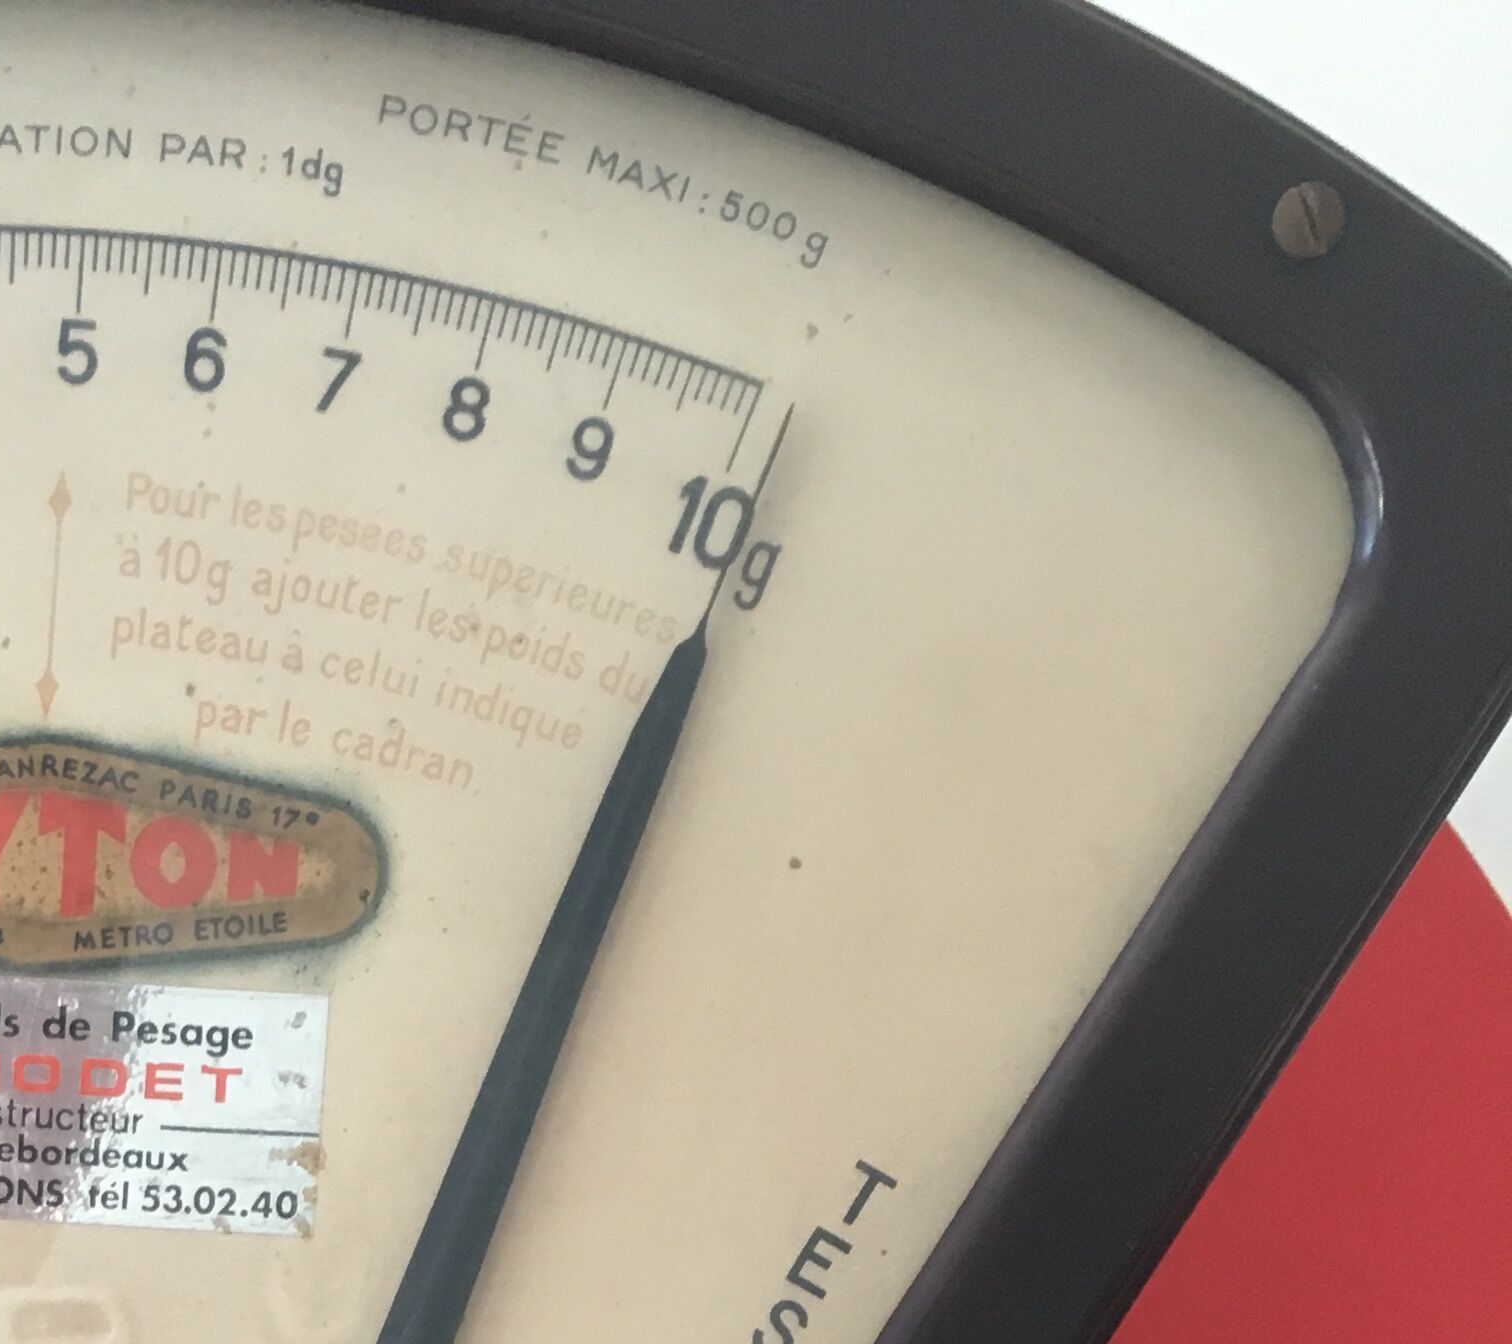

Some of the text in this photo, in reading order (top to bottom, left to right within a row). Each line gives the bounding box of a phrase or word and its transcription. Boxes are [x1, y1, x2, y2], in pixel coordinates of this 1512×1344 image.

[378, 94, 566, 165] PORTÉE
[56, 316, 98, 386] 5
[183, 326, 228, 393] 6
[314, 347, 362, 415] 7
[442, 376, 490, 443] 8
[565, 416, 616, 484] 9
[125, 470, 220, 522] Pour
[252, 558, 403, 624] ajouter
[414, 587, 469, 645] les
[480, 622, 587, 682] poids
[110, 606, 269, 664] plateau
[320, 649, 423, 698] celui
[193, 698, 268, 742] par
[278, 697, 311, 746] le
[159, 779, 252, 820] PARIS
[74, 911, 287, 951] METRO ETOILE
[42, 1005, 91, 1042] de
[111, 1010, 255, 1059] Pesage
[140, 1183, 299, 1222] 53.02.40
